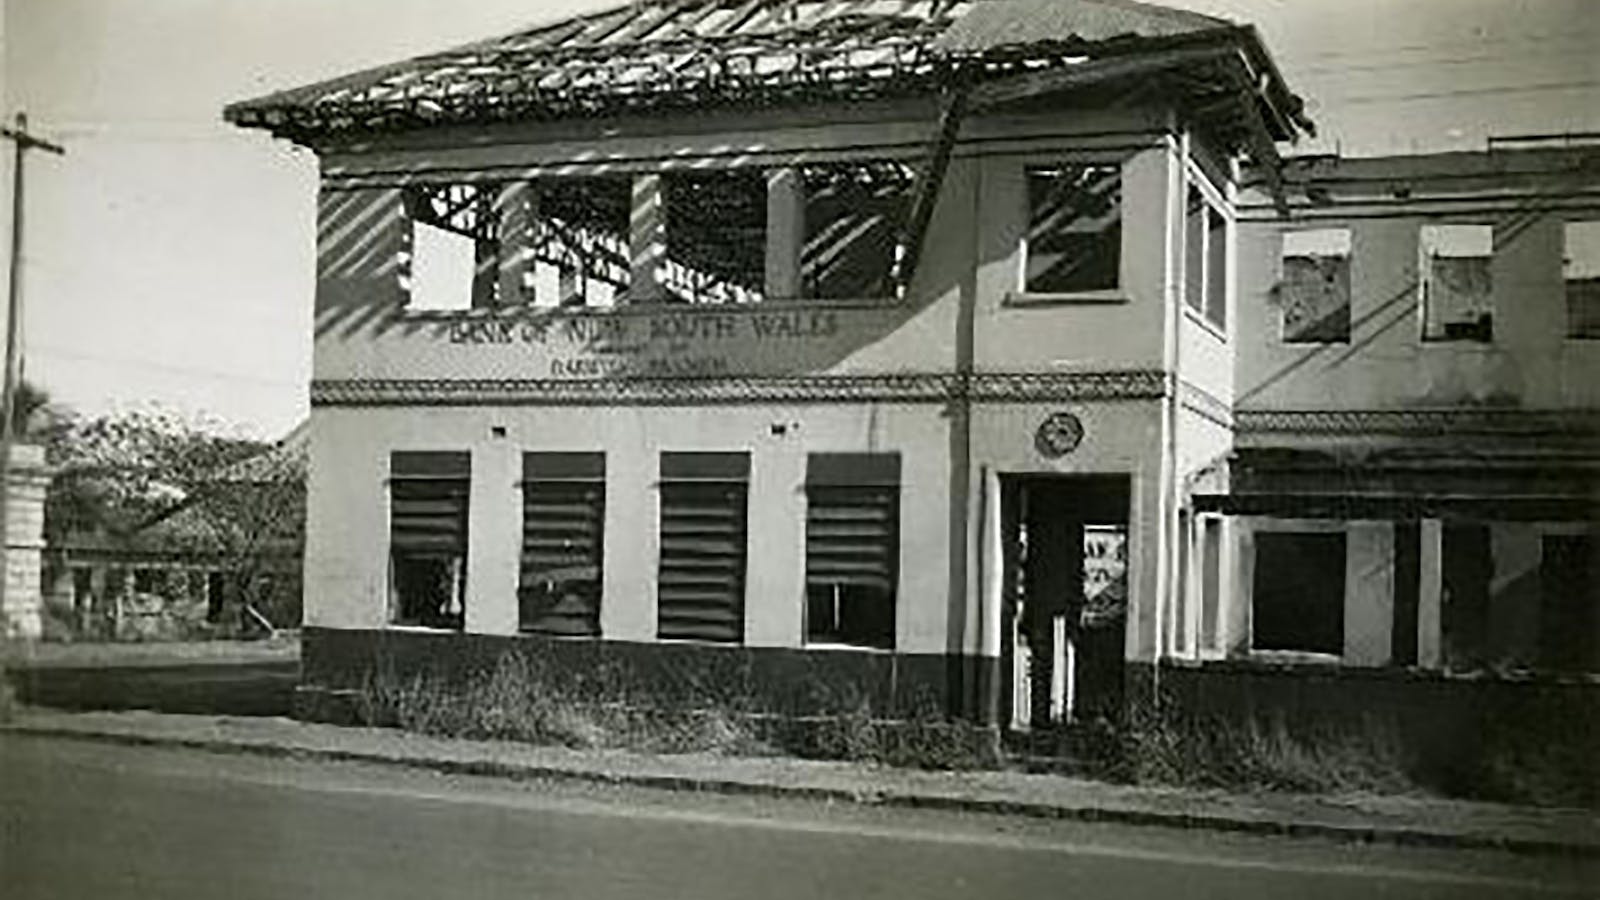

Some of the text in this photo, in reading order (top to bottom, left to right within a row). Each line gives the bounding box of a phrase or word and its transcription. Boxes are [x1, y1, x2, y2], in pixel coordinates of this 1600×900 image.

[449, 318, 512, 344] BANK
[650, 315, 737, 339] SOUTH
[752, 313, 838, 338] WALES
